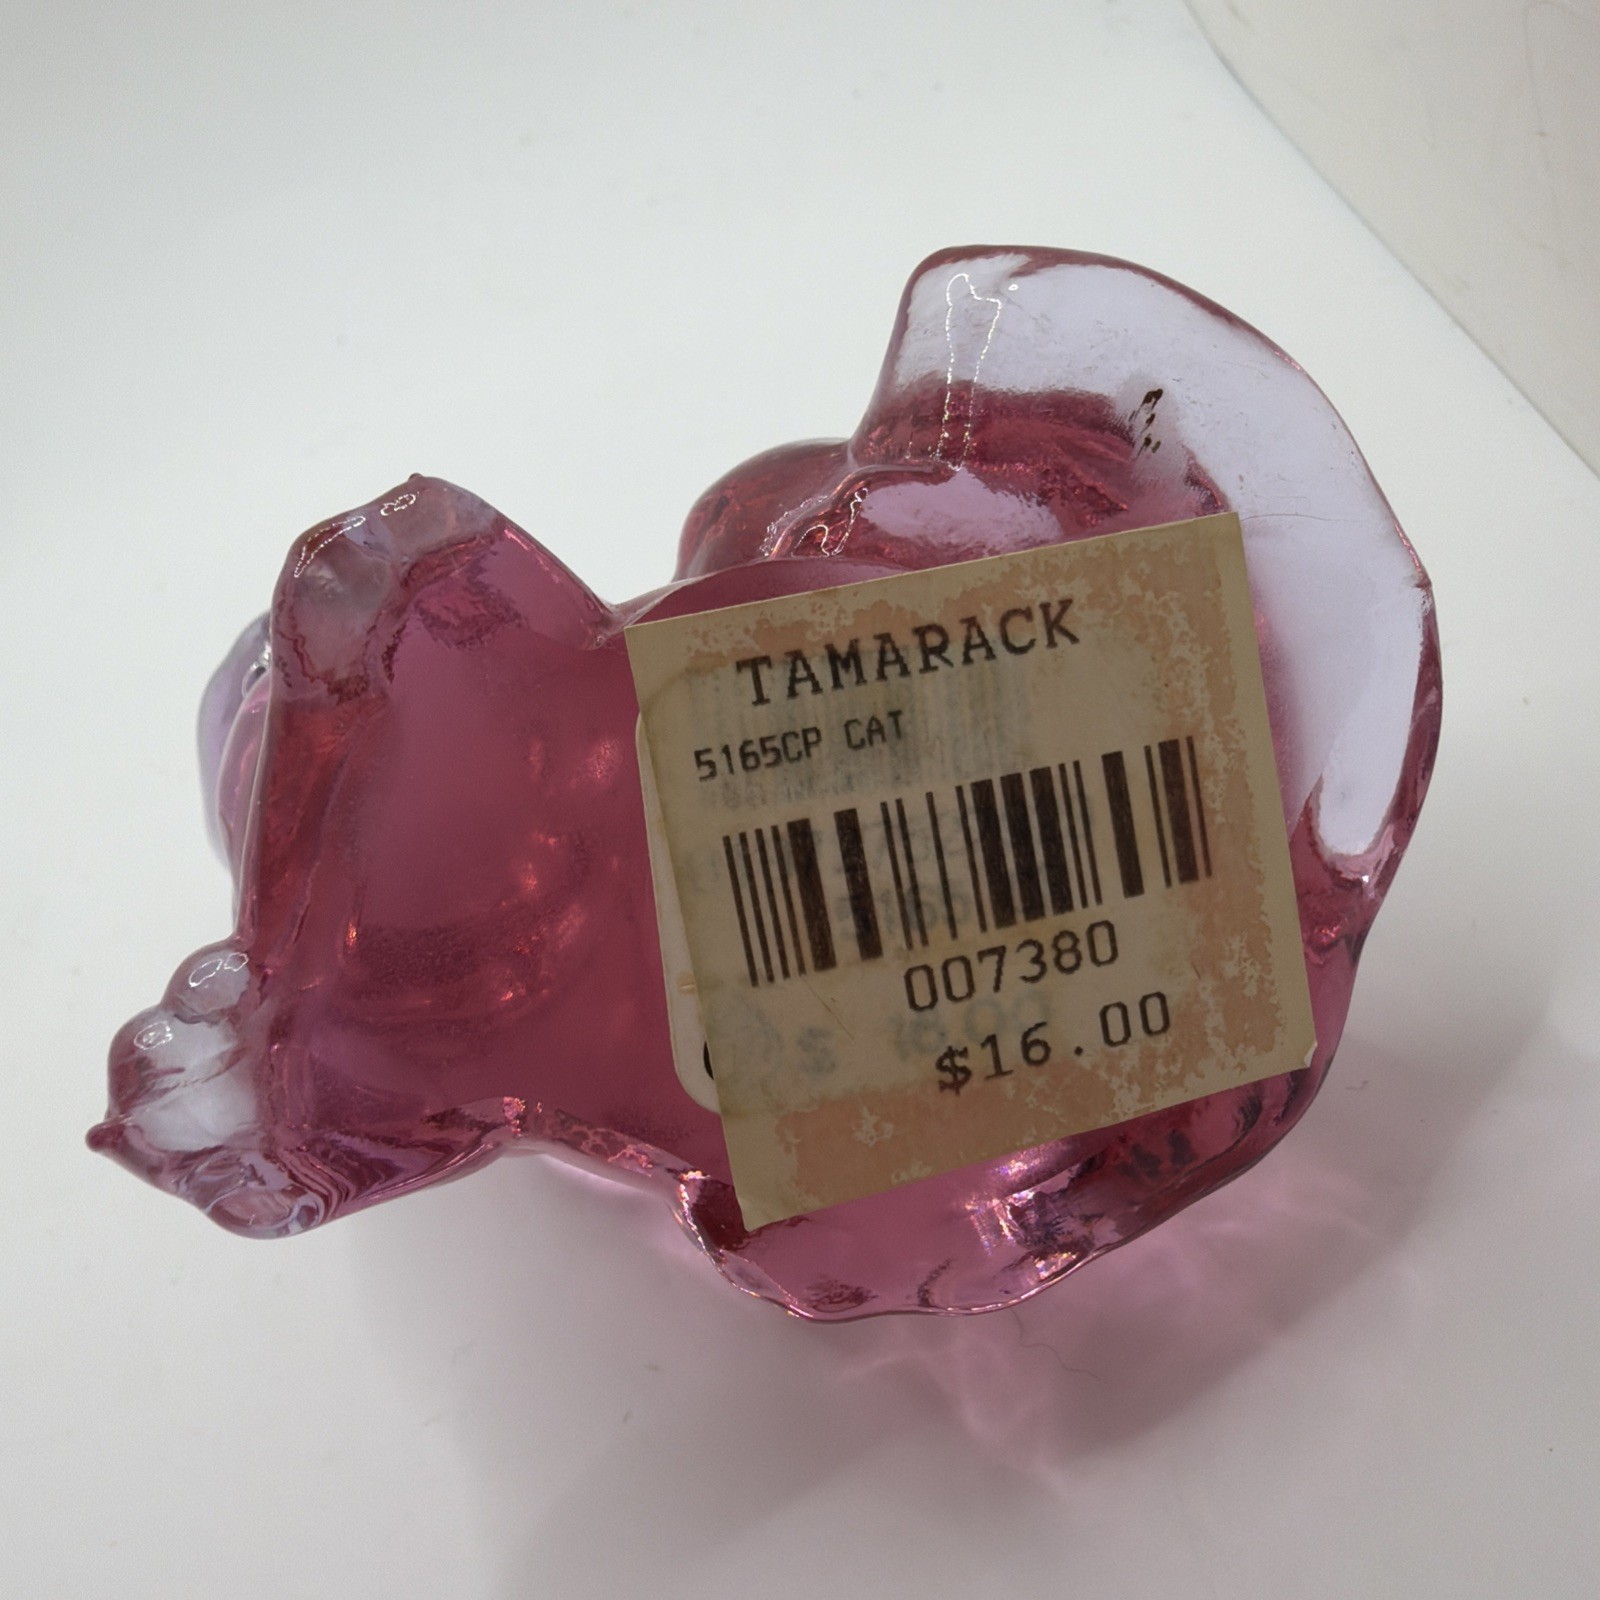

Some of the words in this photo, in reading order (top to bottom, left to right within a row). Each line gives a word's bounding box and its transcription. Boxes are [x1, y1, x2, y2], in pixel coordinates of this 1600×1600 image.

[735, 599, 1080, 706] TAMARACK
[693, 726, 823, 782] 5165CP
[843, 709, 903, 751] CAT
[903, 919, 1119, 1012] 007380
